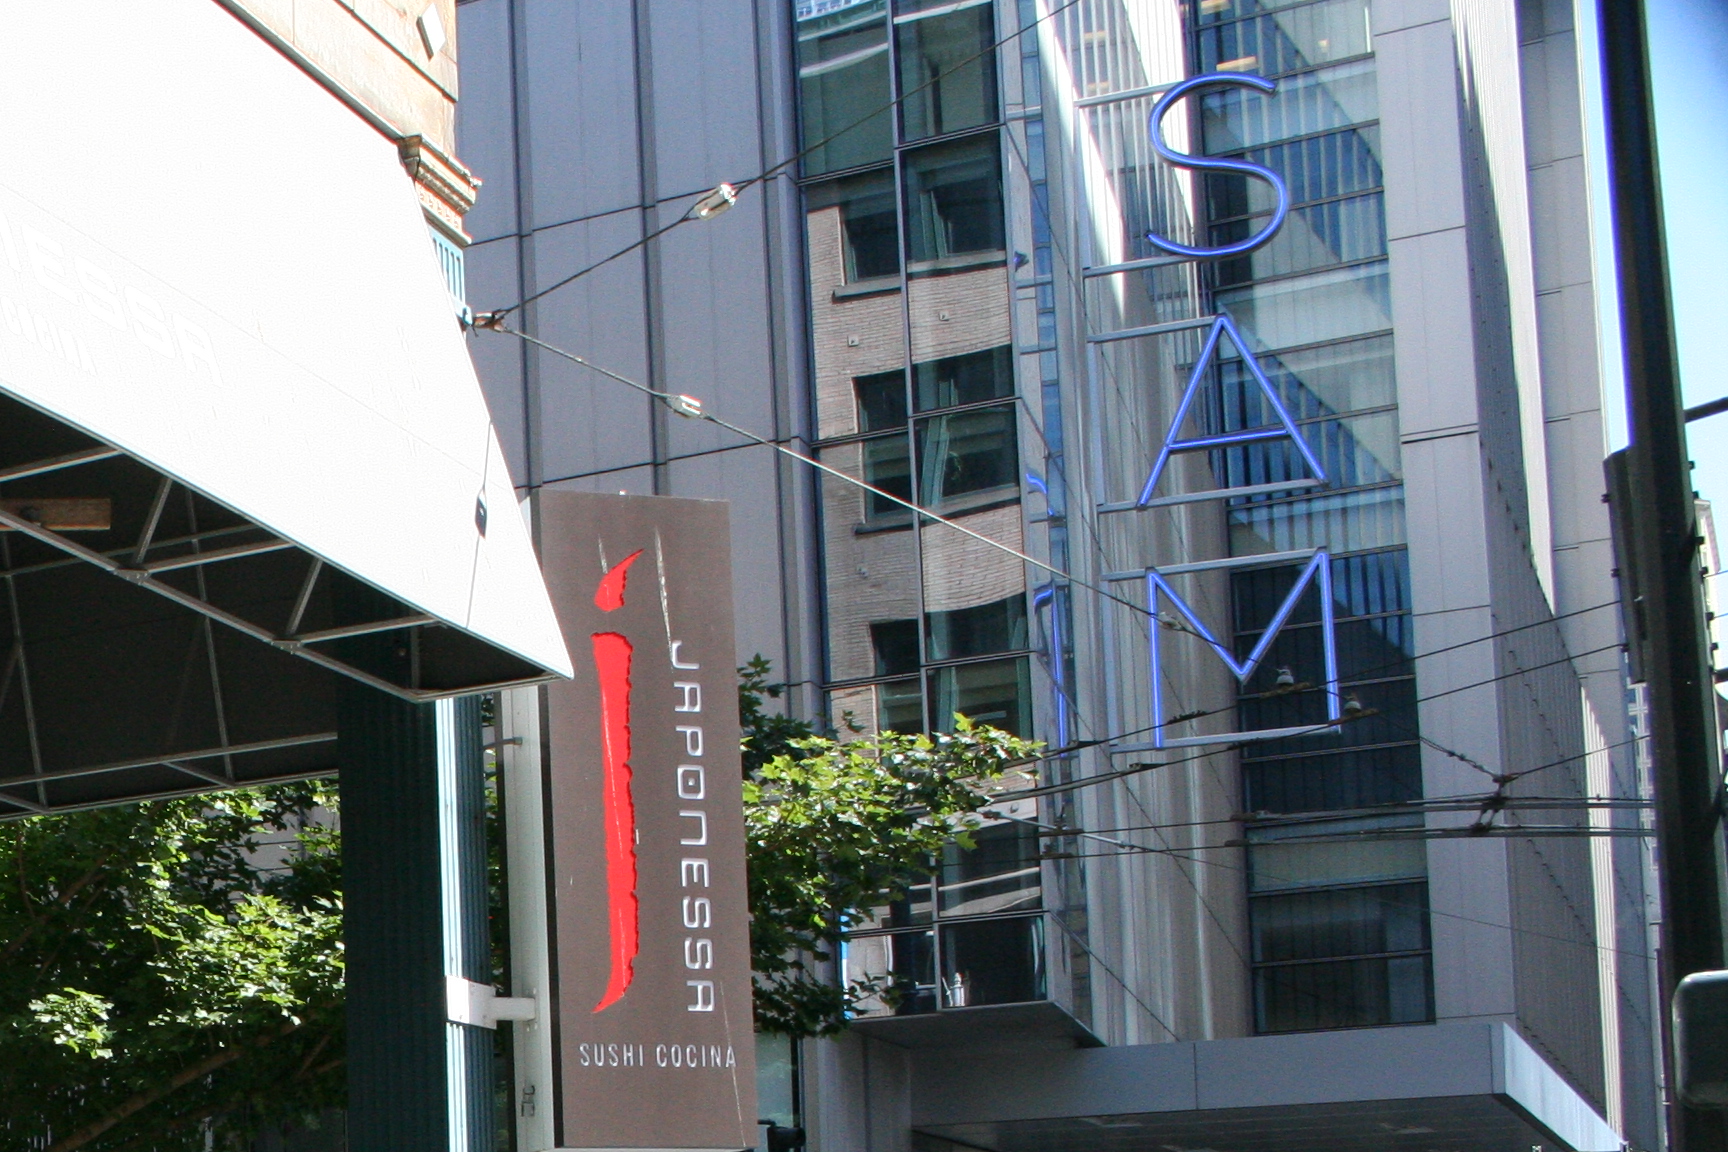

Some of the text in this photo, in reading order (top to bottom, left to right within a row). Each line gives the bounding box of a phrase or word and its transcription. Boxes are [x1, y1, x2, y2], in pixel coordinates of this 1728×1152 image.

[1139, 72, 1342, 748] SAM
[672, 639, 715, 1014] JAPONESSA
[579, 1042, 736, 1068] SUSHI COCINA
